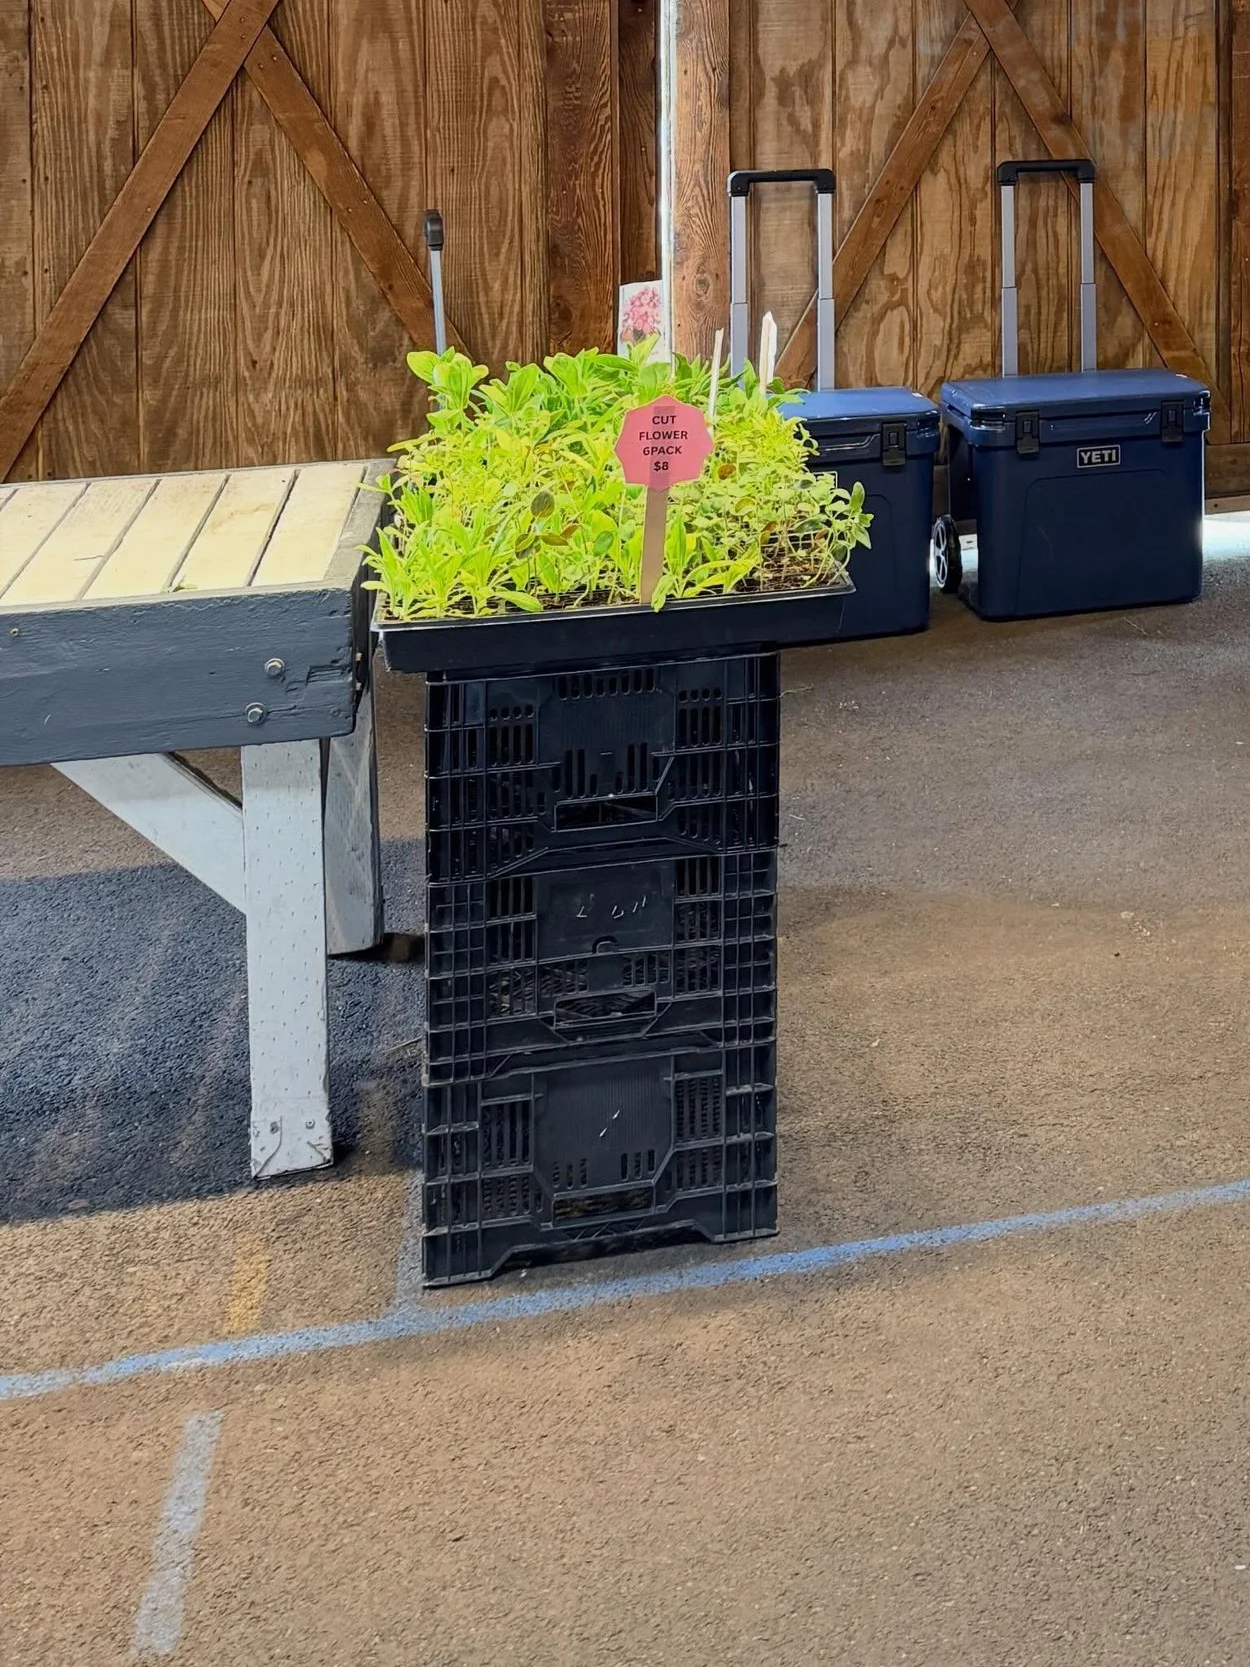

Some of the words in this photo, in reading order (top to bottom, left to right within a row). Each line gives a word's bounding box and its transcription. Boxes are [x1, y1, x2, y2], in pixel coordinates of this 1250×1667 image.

[652, 414, 677, 425] CUT
[639, 430, 689, 441] FLOWER
[642, 445, 682, 456] 6PACK
[1080, 449, 1118, 464] YETI
[653, 460, 669, 472] $8
